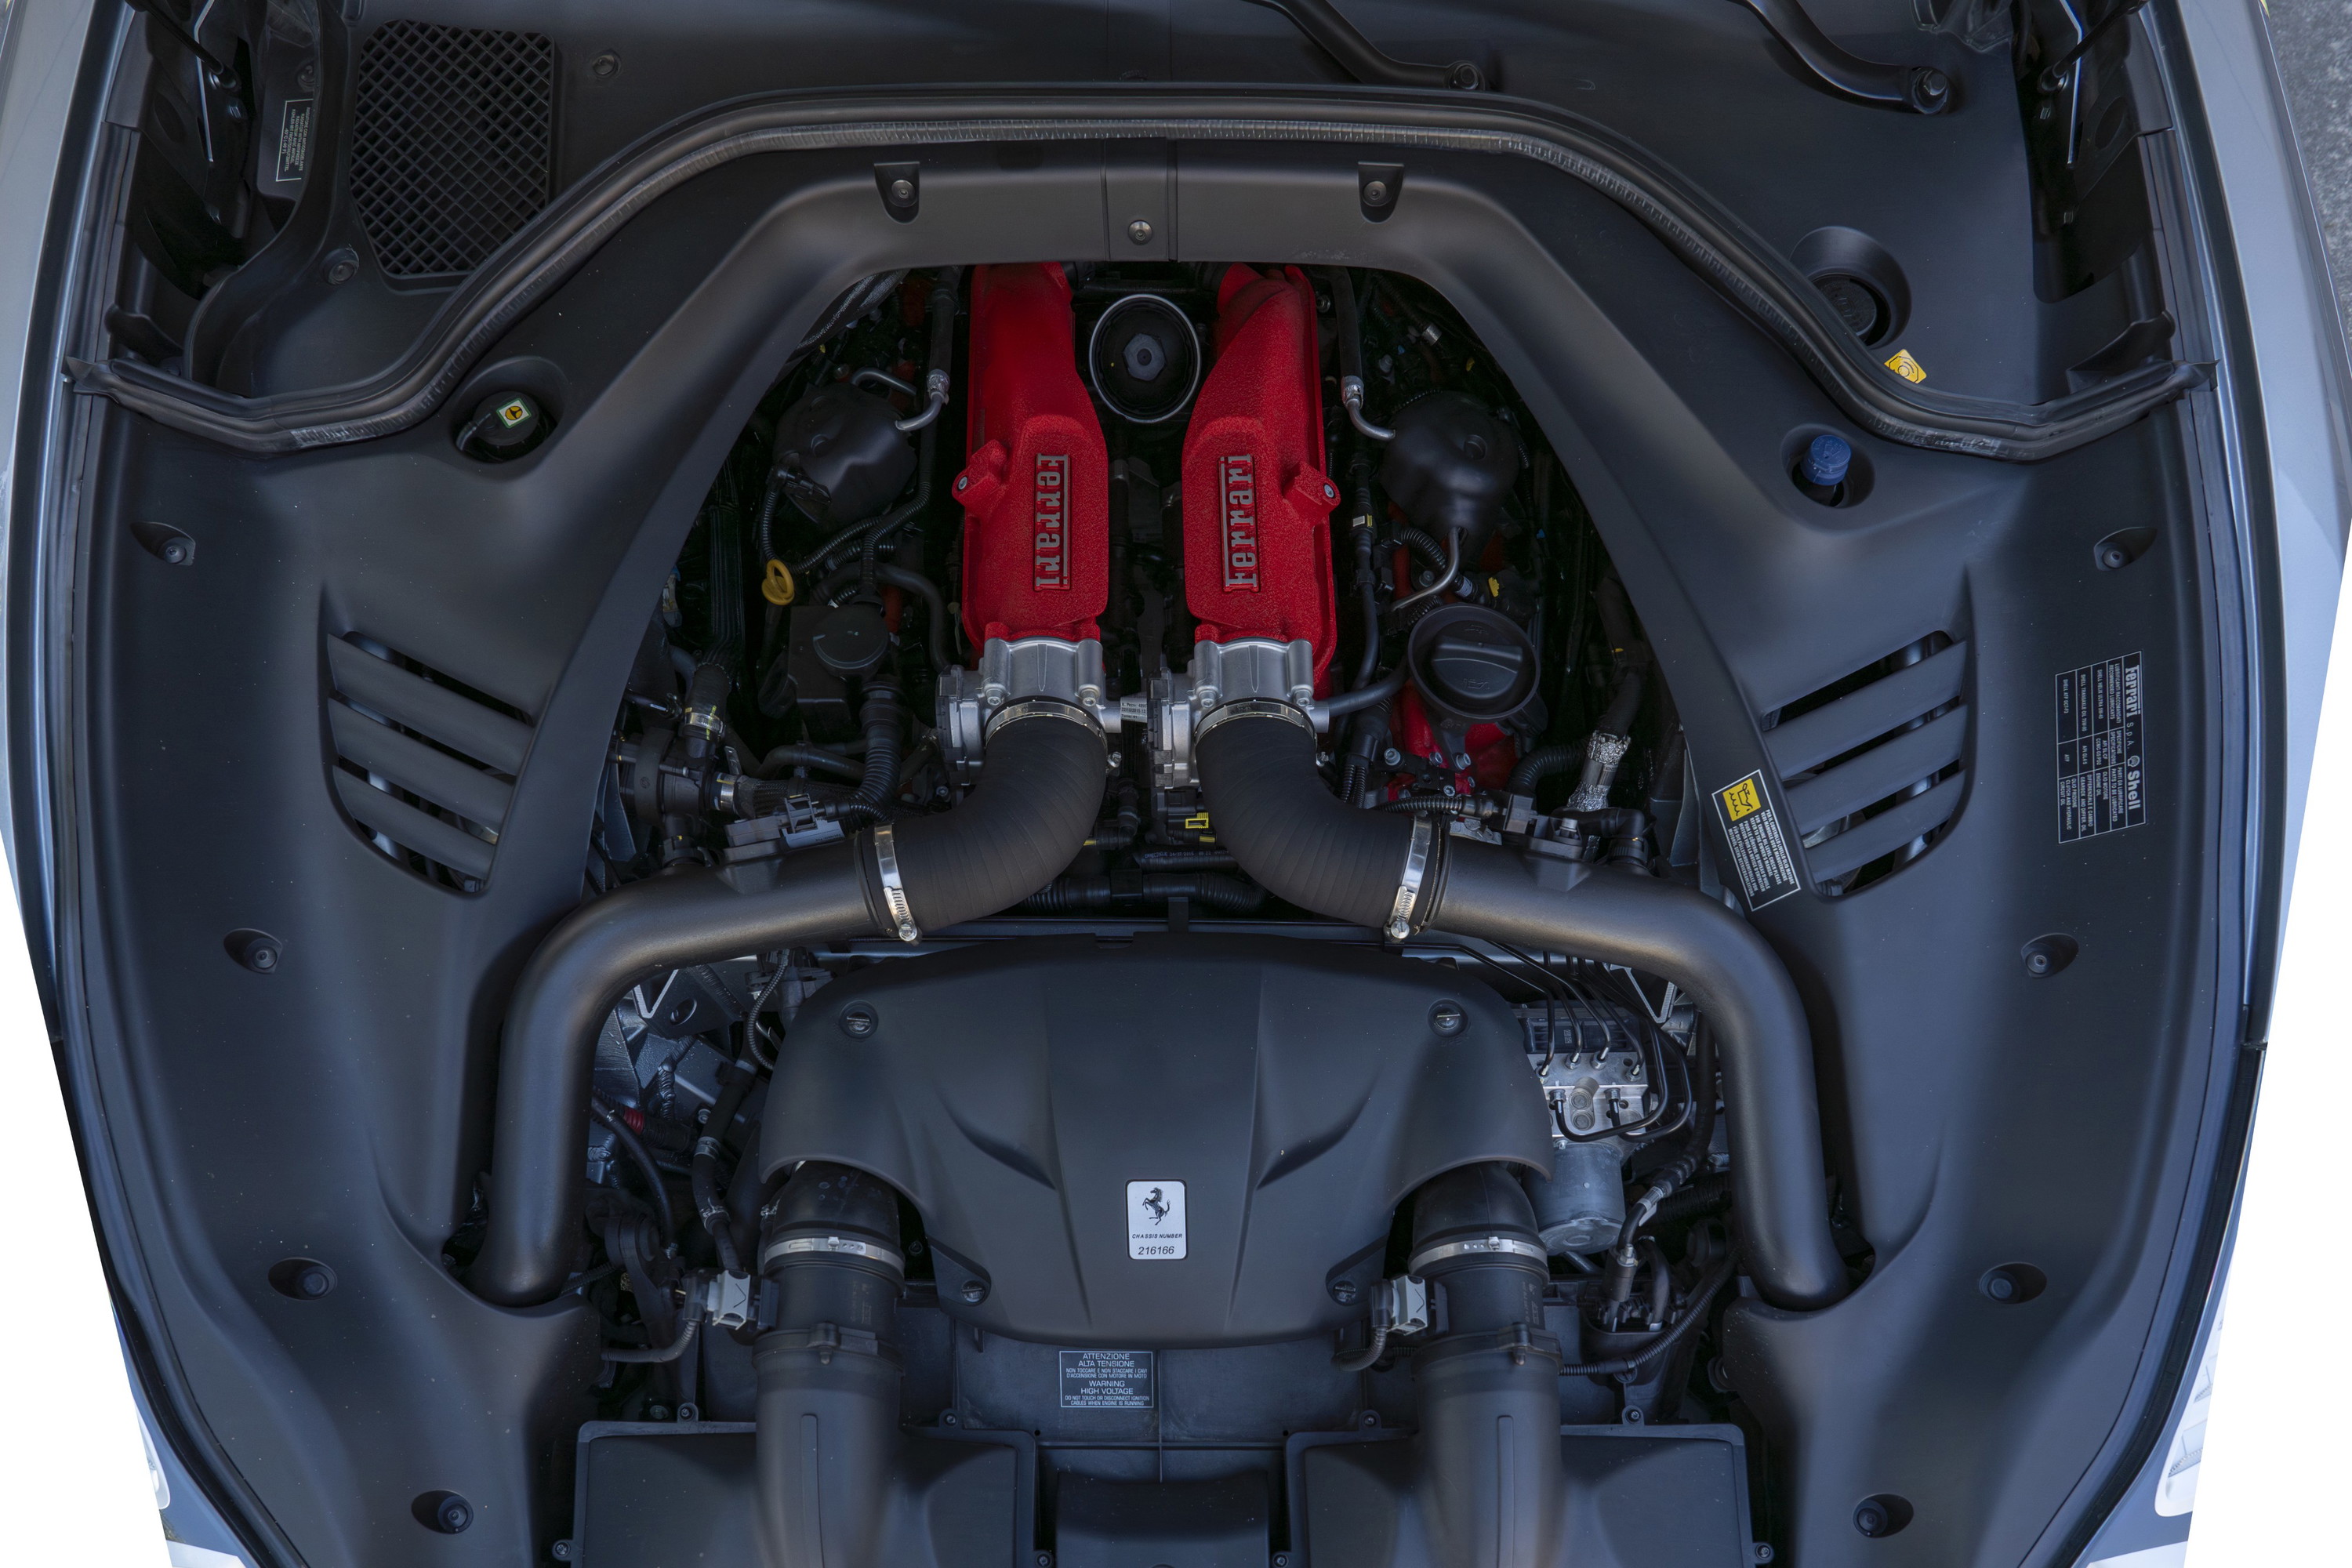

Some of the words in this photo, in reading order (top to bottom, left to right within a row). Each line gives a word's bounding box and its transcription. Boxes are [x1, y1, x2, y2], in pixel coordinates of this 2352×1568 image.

[1036, 453, 1069, 586] Ferrari
[1220, 454, 1258, 586] Ferrari
[2125, 665, 2140, 717] Ferrari
[2128, 770, 2140, 810] Shell
[1739, 822, 1748, 840] MOTEUR
[1764, 821, 1773, 840] MANUALE
[1774, 851, 1788, 881] MANUTENZIONE
[1770, 822, 1780, 844] CONTROLLO
[1777, 844, 1786, 859] LIVELLO
[1786, 868, 1795, 884] MOTORE
[1764, 860, 1773, 877] MANUAL
[1138, 1246, 1174, 1255] 216166
